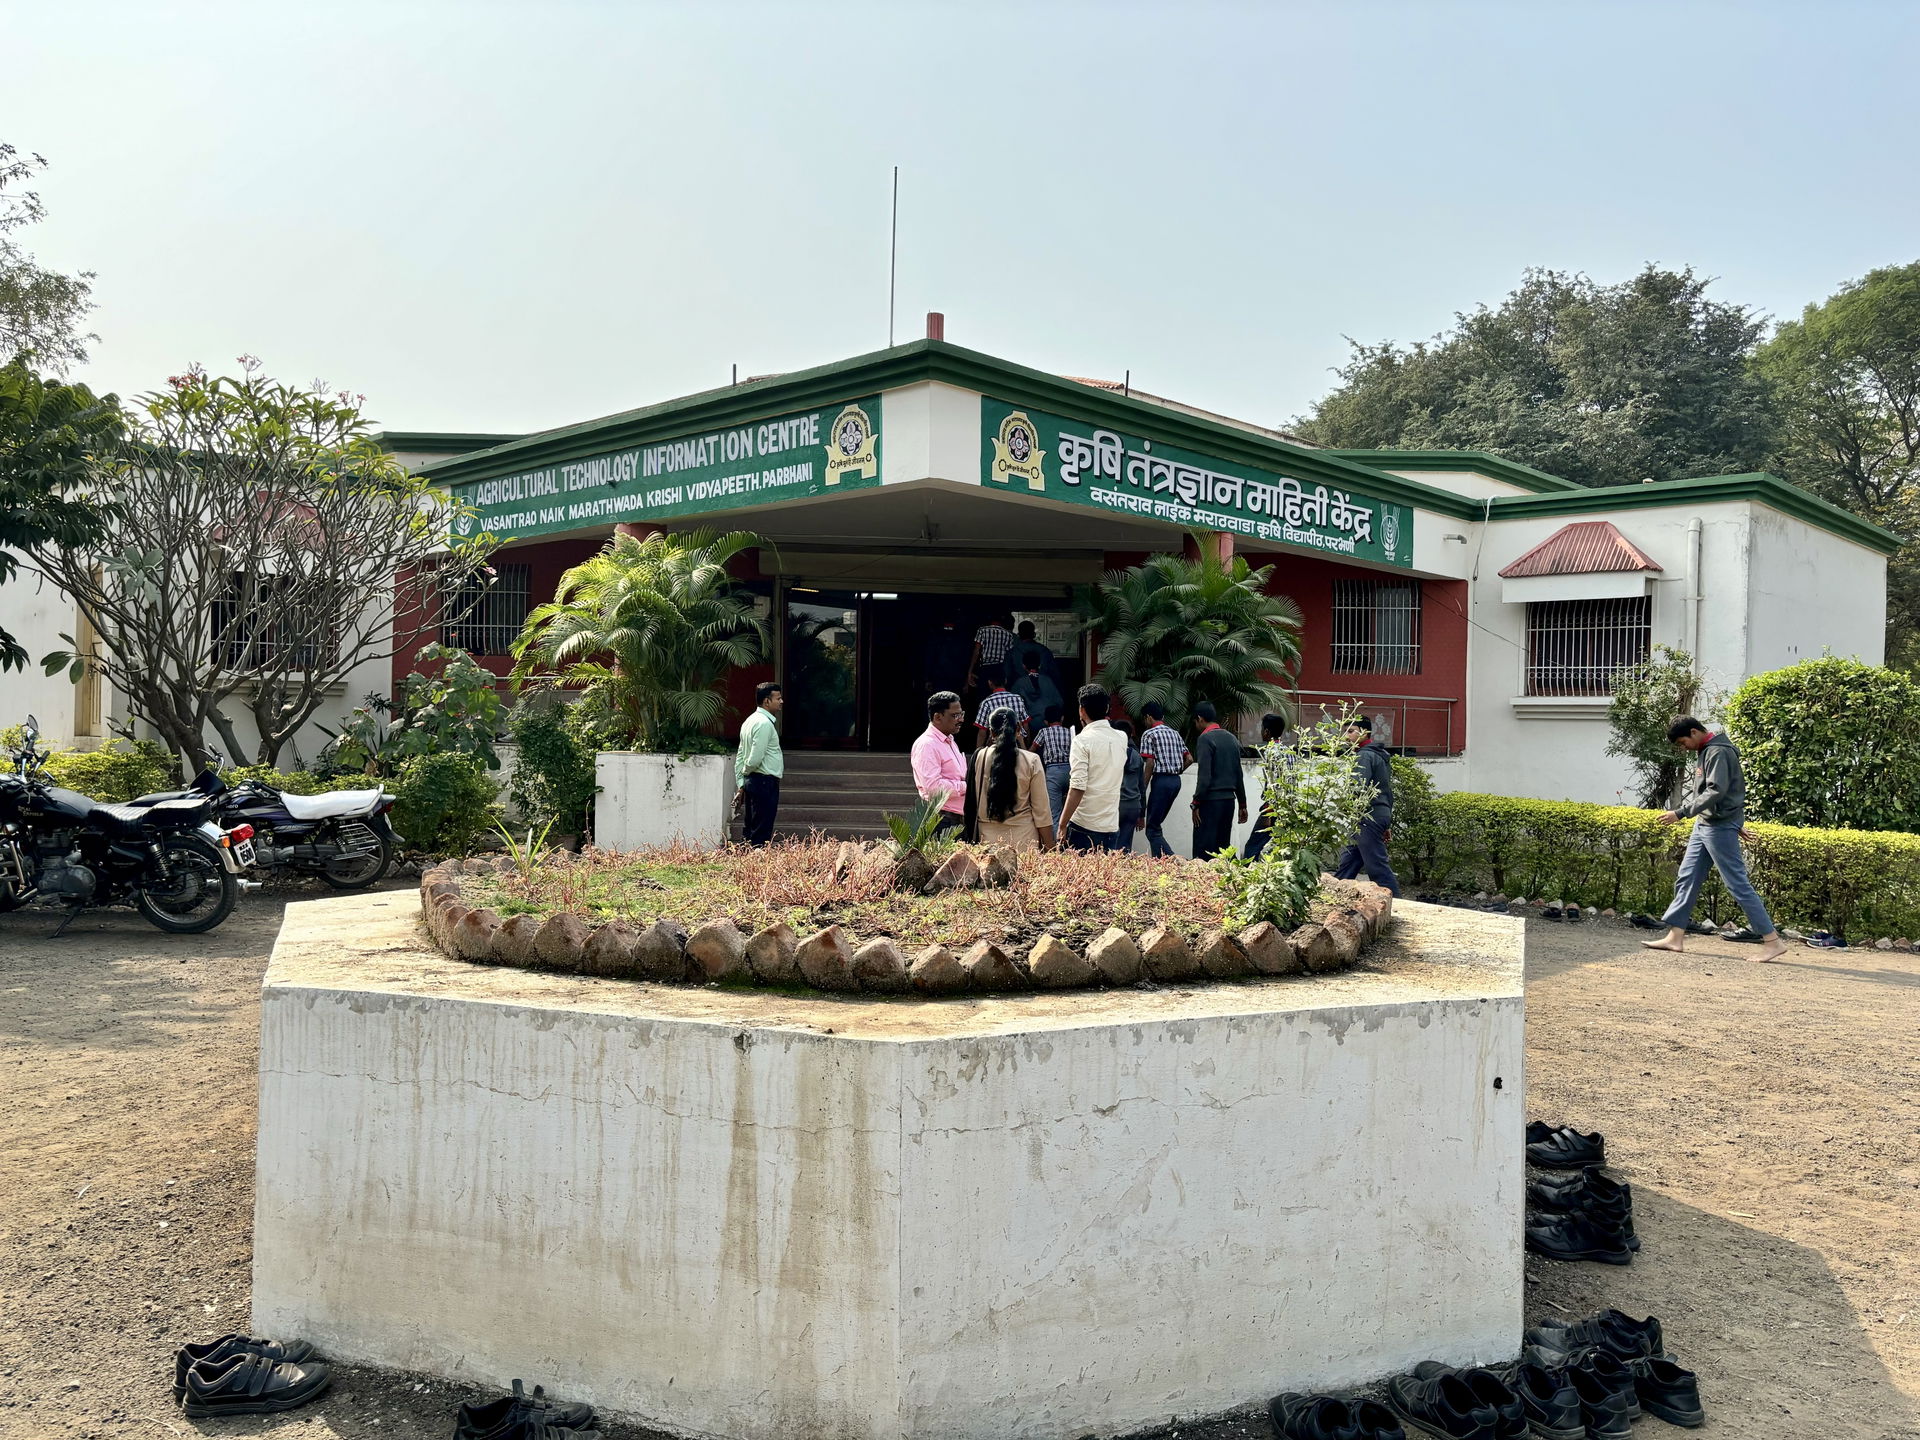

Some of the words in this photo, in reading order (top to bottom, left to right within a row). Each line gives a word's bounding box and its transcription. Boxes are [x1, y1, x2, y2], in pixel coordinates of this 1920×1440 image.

[475, 473, 560, 507] AGRICULTURAL
[561, 451, 638, 493] TECHNOLOGY
[643, 428, 753, 477] INFORMATION
[757, 413, 820, 456] CENTRE
[1058, 430, 1125, 485] कृषि
[1127, 440, 1245, 509] तंत्रज्ञान
[1247, 477, 1330, 527] माहिती
[1330, 490, 1373, 543] केंद्र
[480, 511, 537, 532] VASANTRAO
[539, 505, 565, 523] NAIK
[568, 492, 644, 520] MARATHWADA
[646, 486, 683, 508] KRISHI
[1089, 486, 1153, 514] वसंतराव
[1154, 498, 1192, 523] नाईक
[1193, 508, 1256, 534] मराठवाडा
[1256, 519, 1282, 539] कृषि
